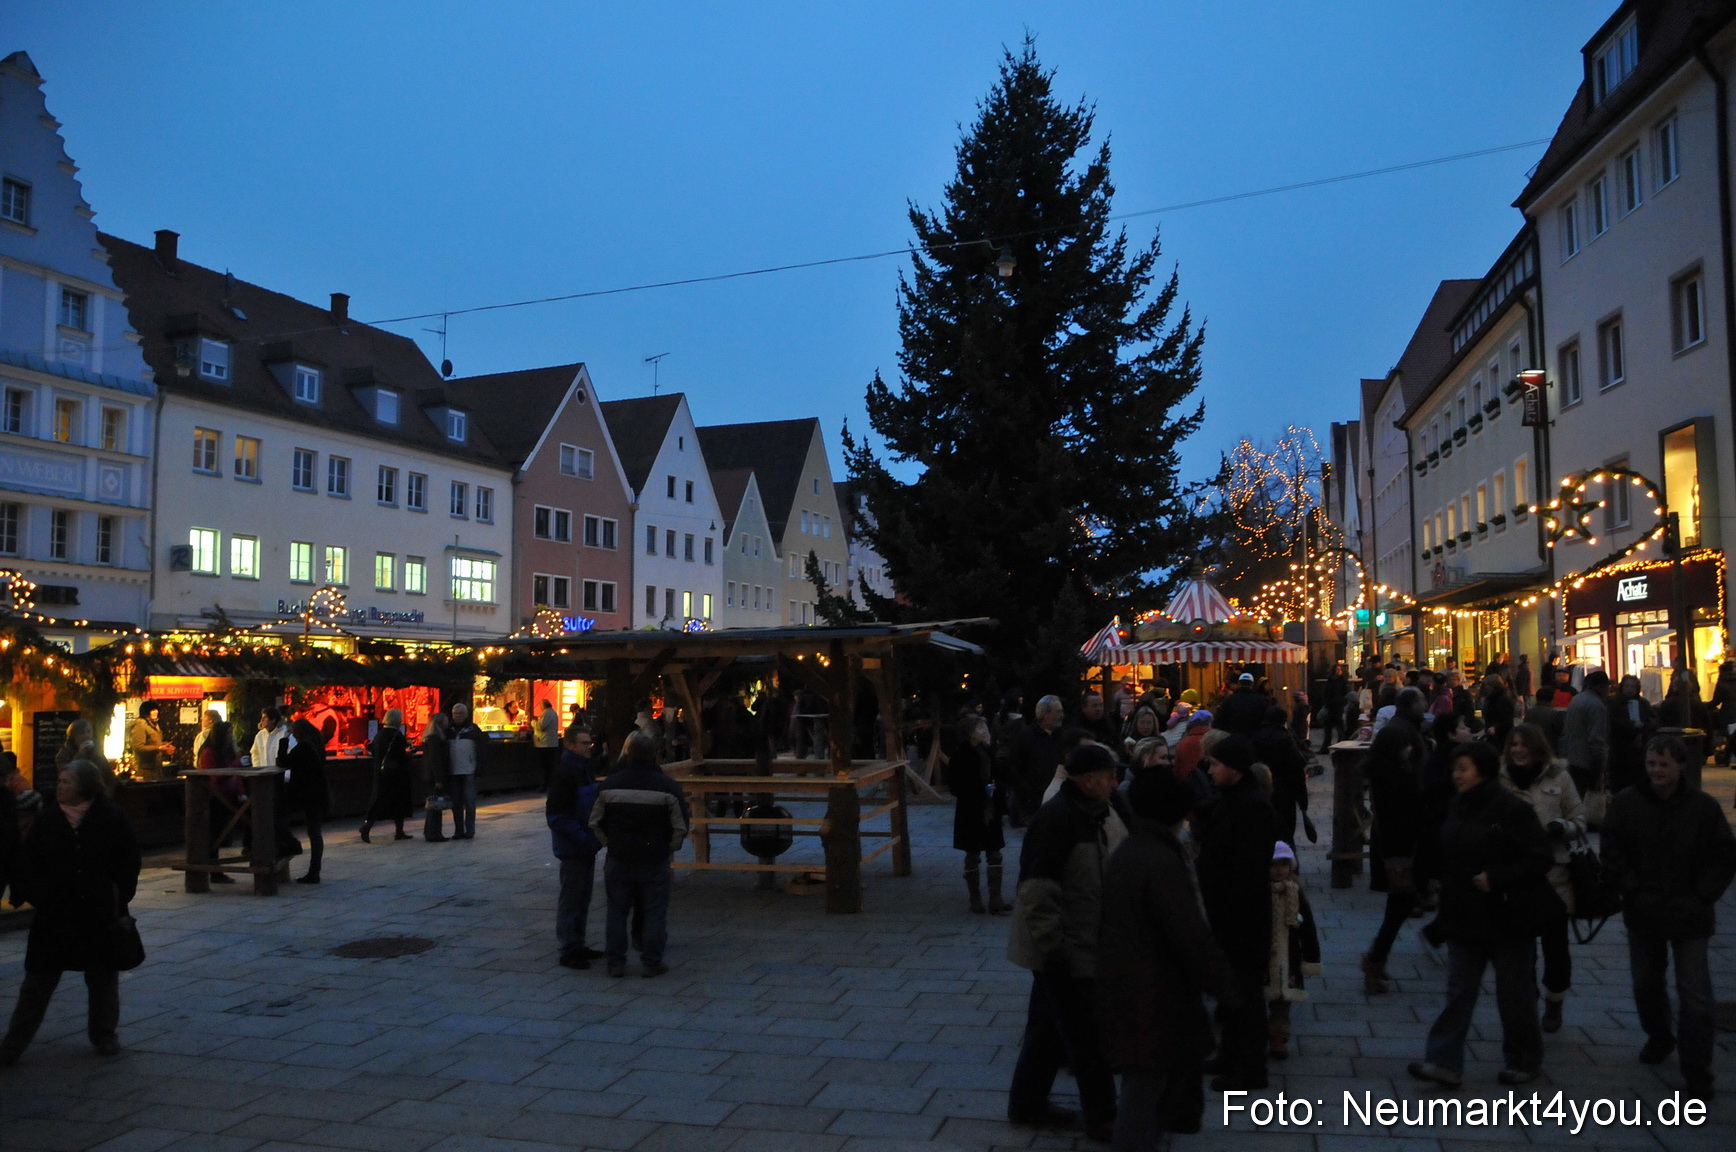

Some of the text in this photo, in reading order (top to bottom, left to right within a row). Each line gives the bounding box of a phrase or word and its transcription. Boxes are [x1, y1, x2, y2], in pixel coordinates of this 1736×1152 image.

[1524, 381, 1539, 423] Achatz
[16, 459, 74, 482] WEBER
[1616, 575, 1649, 602] Achatz
